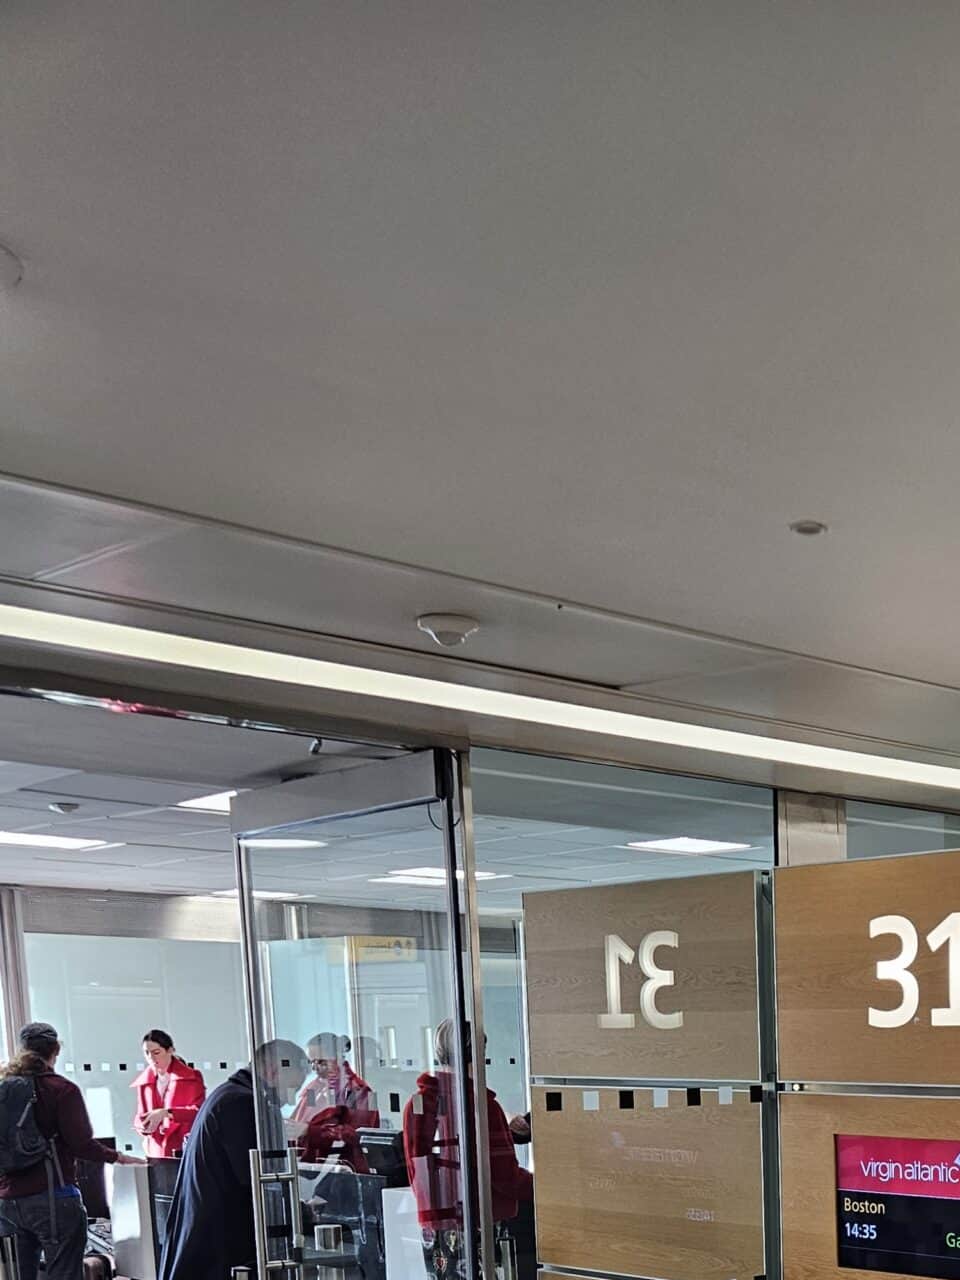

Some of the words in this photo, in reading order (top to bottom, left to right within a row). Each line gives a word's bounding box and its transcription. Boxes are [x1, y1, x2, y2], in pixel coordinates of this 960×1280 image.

[860, 1157, 903, 1182] virgin
[904, 1160, 960, 1184] atlantic
[844, 1197, 885, 1215] Boston
[844, 1222, 877, 1240] 14:35
